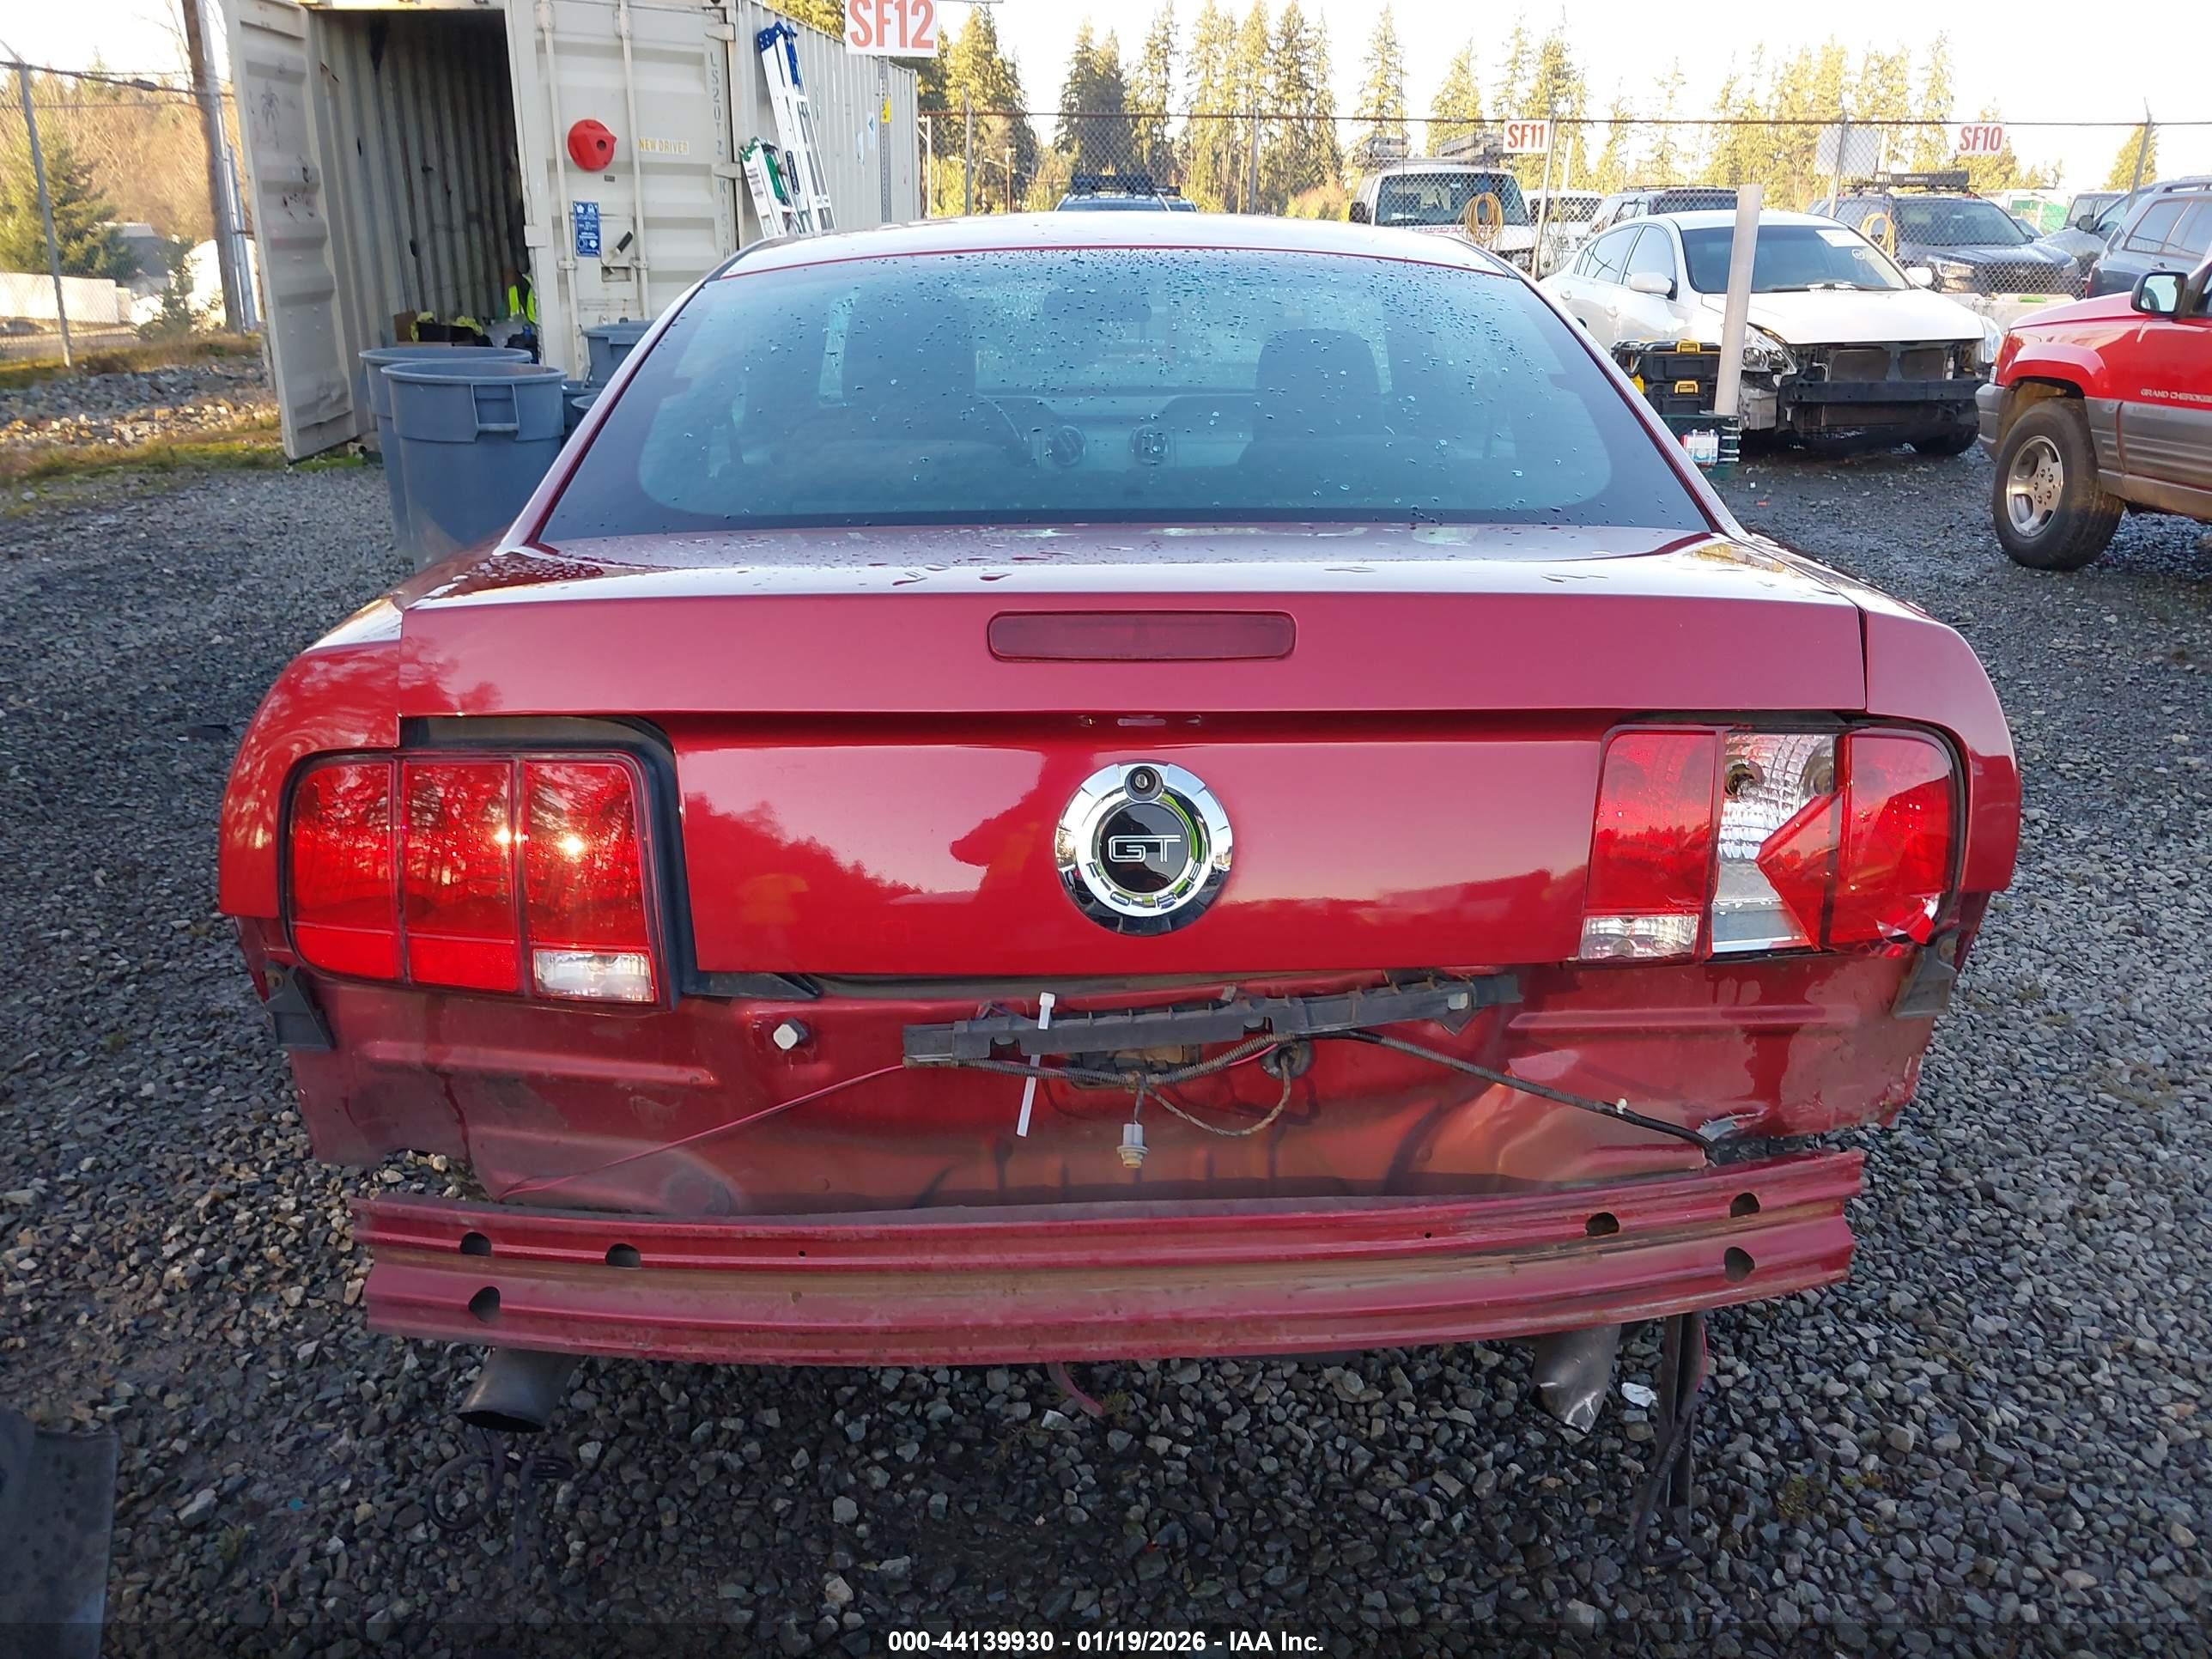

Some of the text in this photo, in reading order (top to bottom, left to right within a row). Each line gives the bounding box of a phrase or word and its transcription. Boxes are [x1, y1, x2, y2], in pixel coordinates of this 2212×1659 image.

[849, 0, 934, 48] SF12
[1508, 124, 1545, 149] SF11
[1960, 126, 2002, 151] SF10
[2140, 388, 2169, 398] GRAND
[1108, 835, 1182, 863] GT
